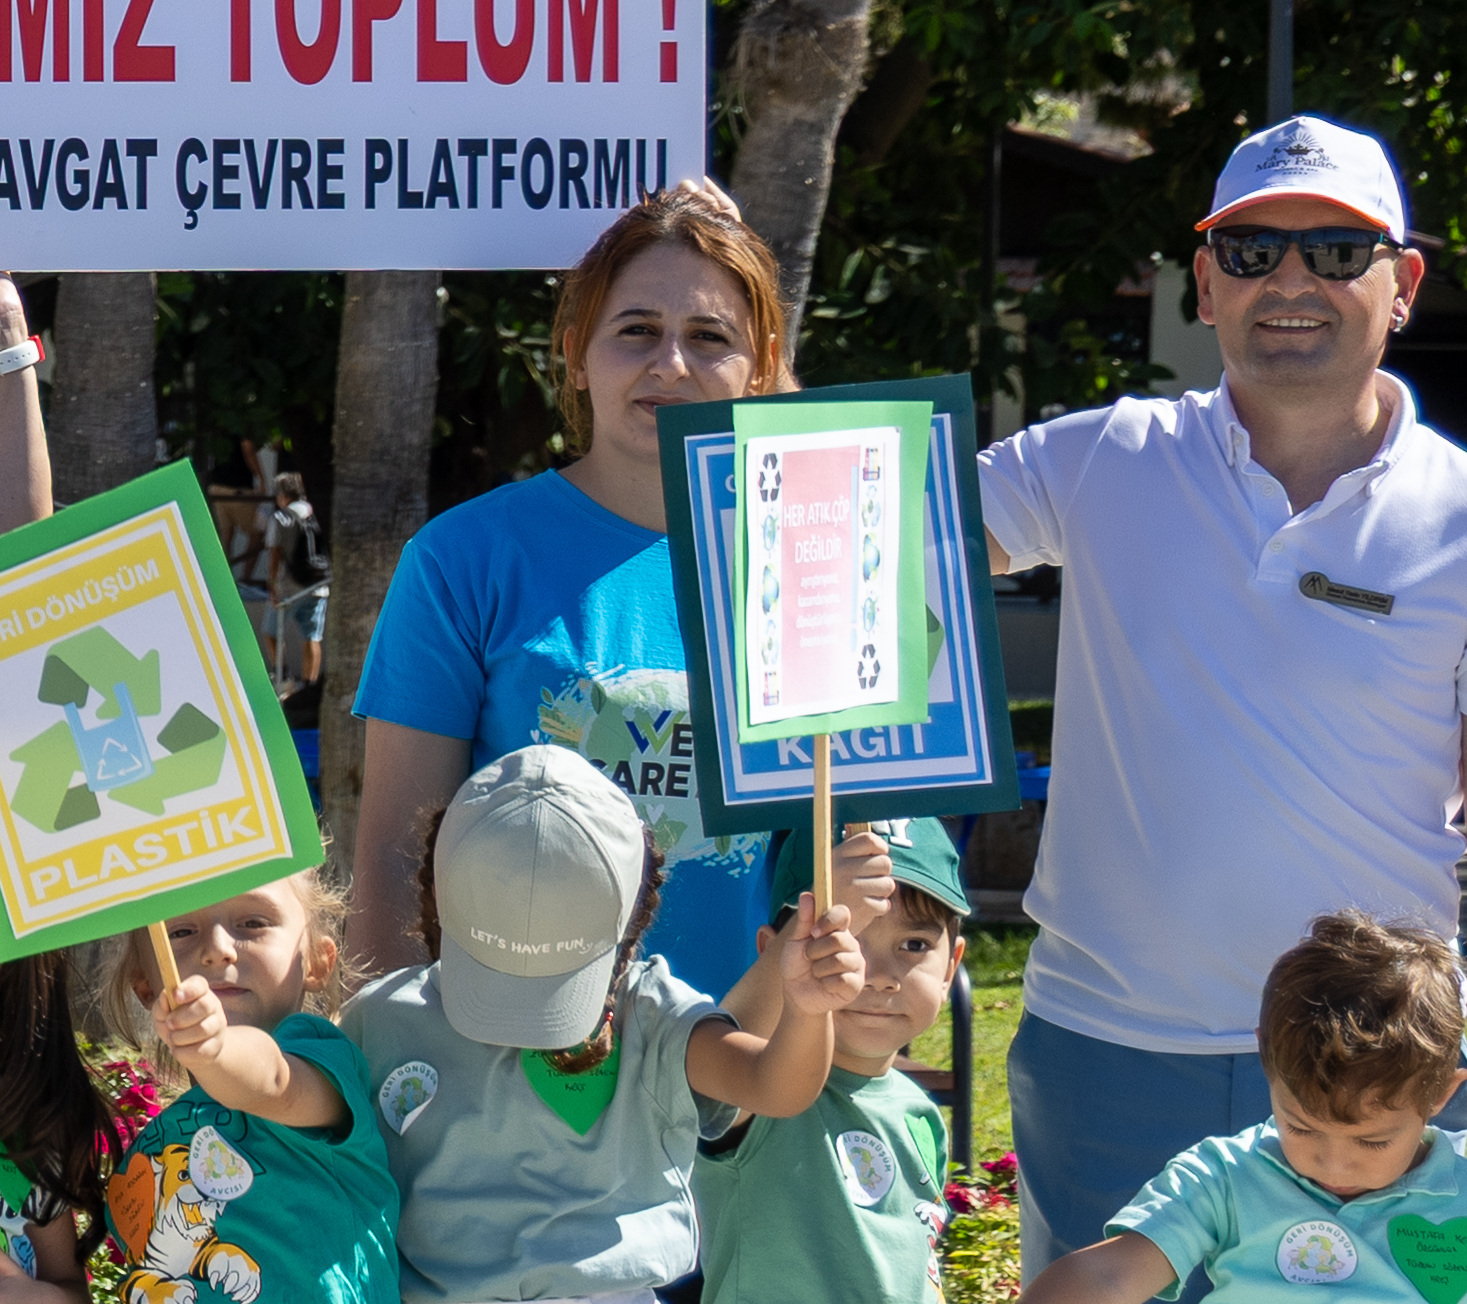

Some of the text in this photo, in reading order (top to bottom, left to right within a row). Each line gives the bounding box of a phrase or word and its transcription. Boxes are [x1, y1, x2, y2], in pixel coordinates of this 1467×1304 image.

[1255, 157, 1339, 173] Mary Palace
[177, 137, 346, 231] ÇEVRE
[365, 138, 667, 210] PLATFORMU
[783, 500, 806, 529] HER
[25, 558, 160, 630] DÖNÜŞÜM
[624, 710, 694, 755] WE
[28, 805, 257, 900] PLASTİK
[511, 941, 550, 955] HAVE
[556, 938, 584, 952] FUN
[210, 1183, 244, 1196] AVCISI
[1286, 1222, 1354, 1258] GERİ DÖNÜŞÜM
